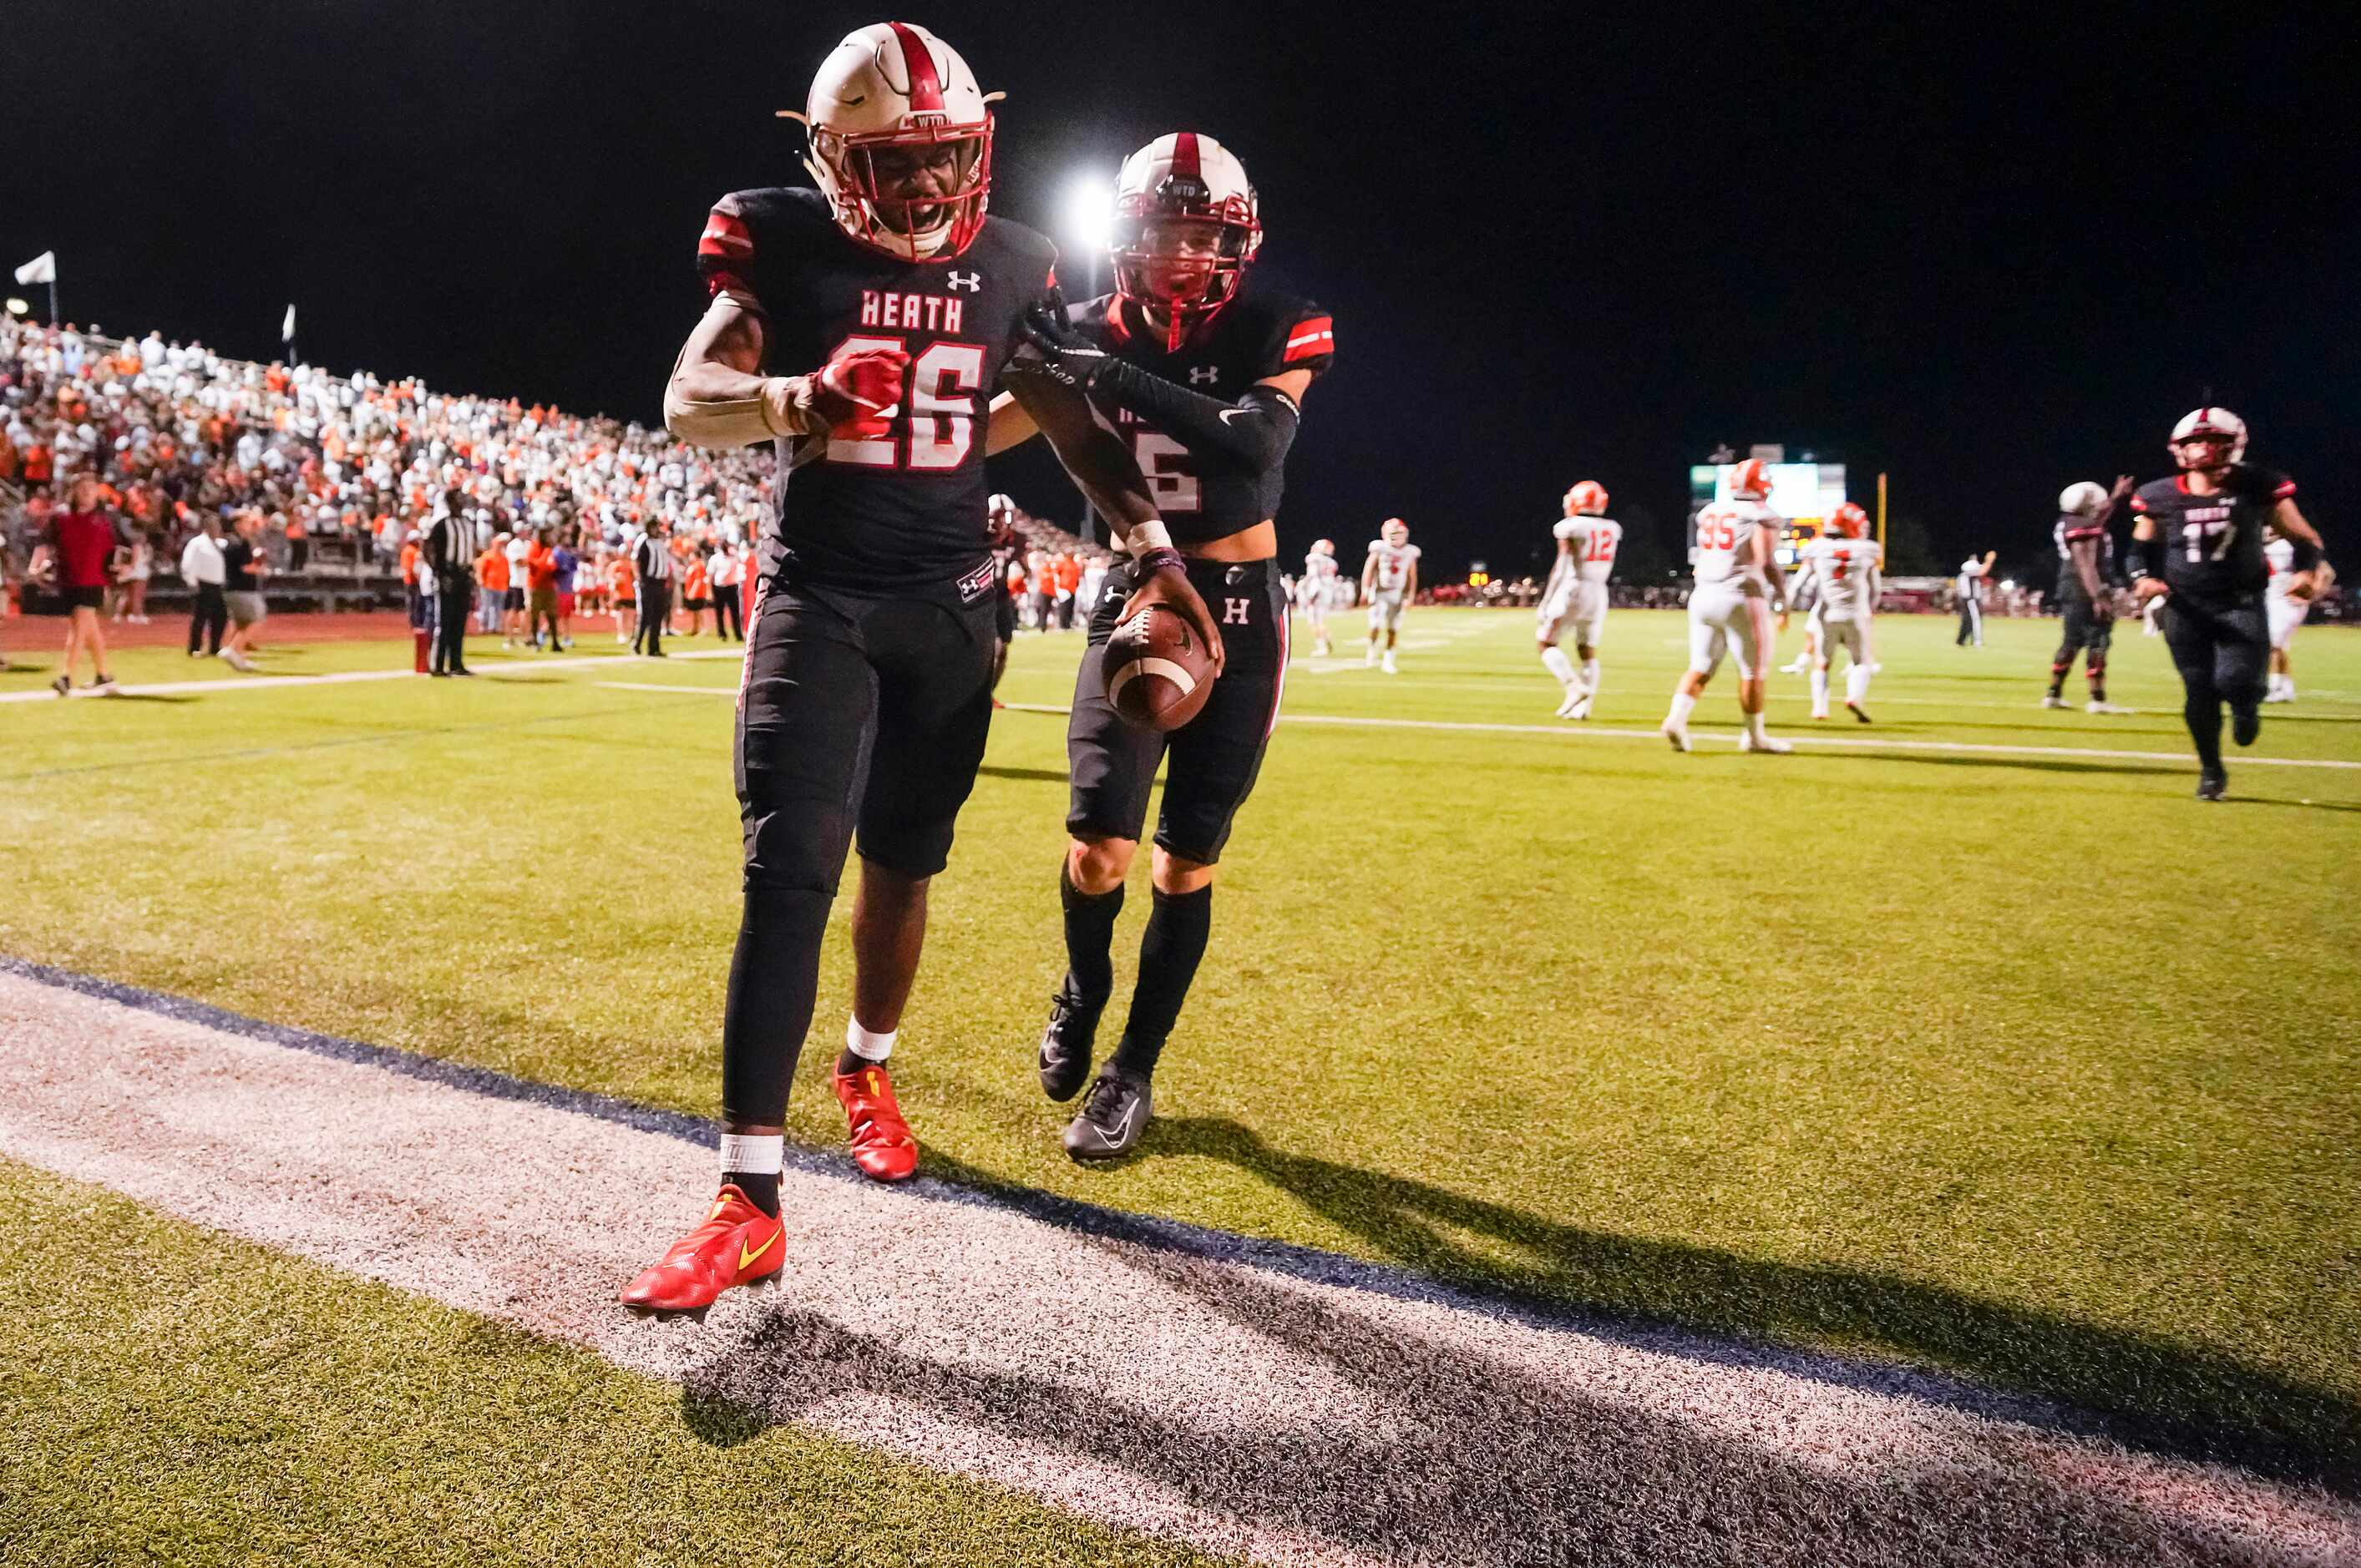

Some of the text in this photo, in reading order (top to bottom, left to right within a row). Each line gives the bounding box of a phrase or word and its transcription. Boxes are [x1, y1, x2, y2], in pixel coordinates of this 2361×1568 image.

[861, 290, 962, 333] HEATH
[1584, 529, 1614, 562] 12
[1701, 512, 1738, 551] 95
[2181, 520, 2238, 564] 17
[1222, 597, 1250, 625] H
